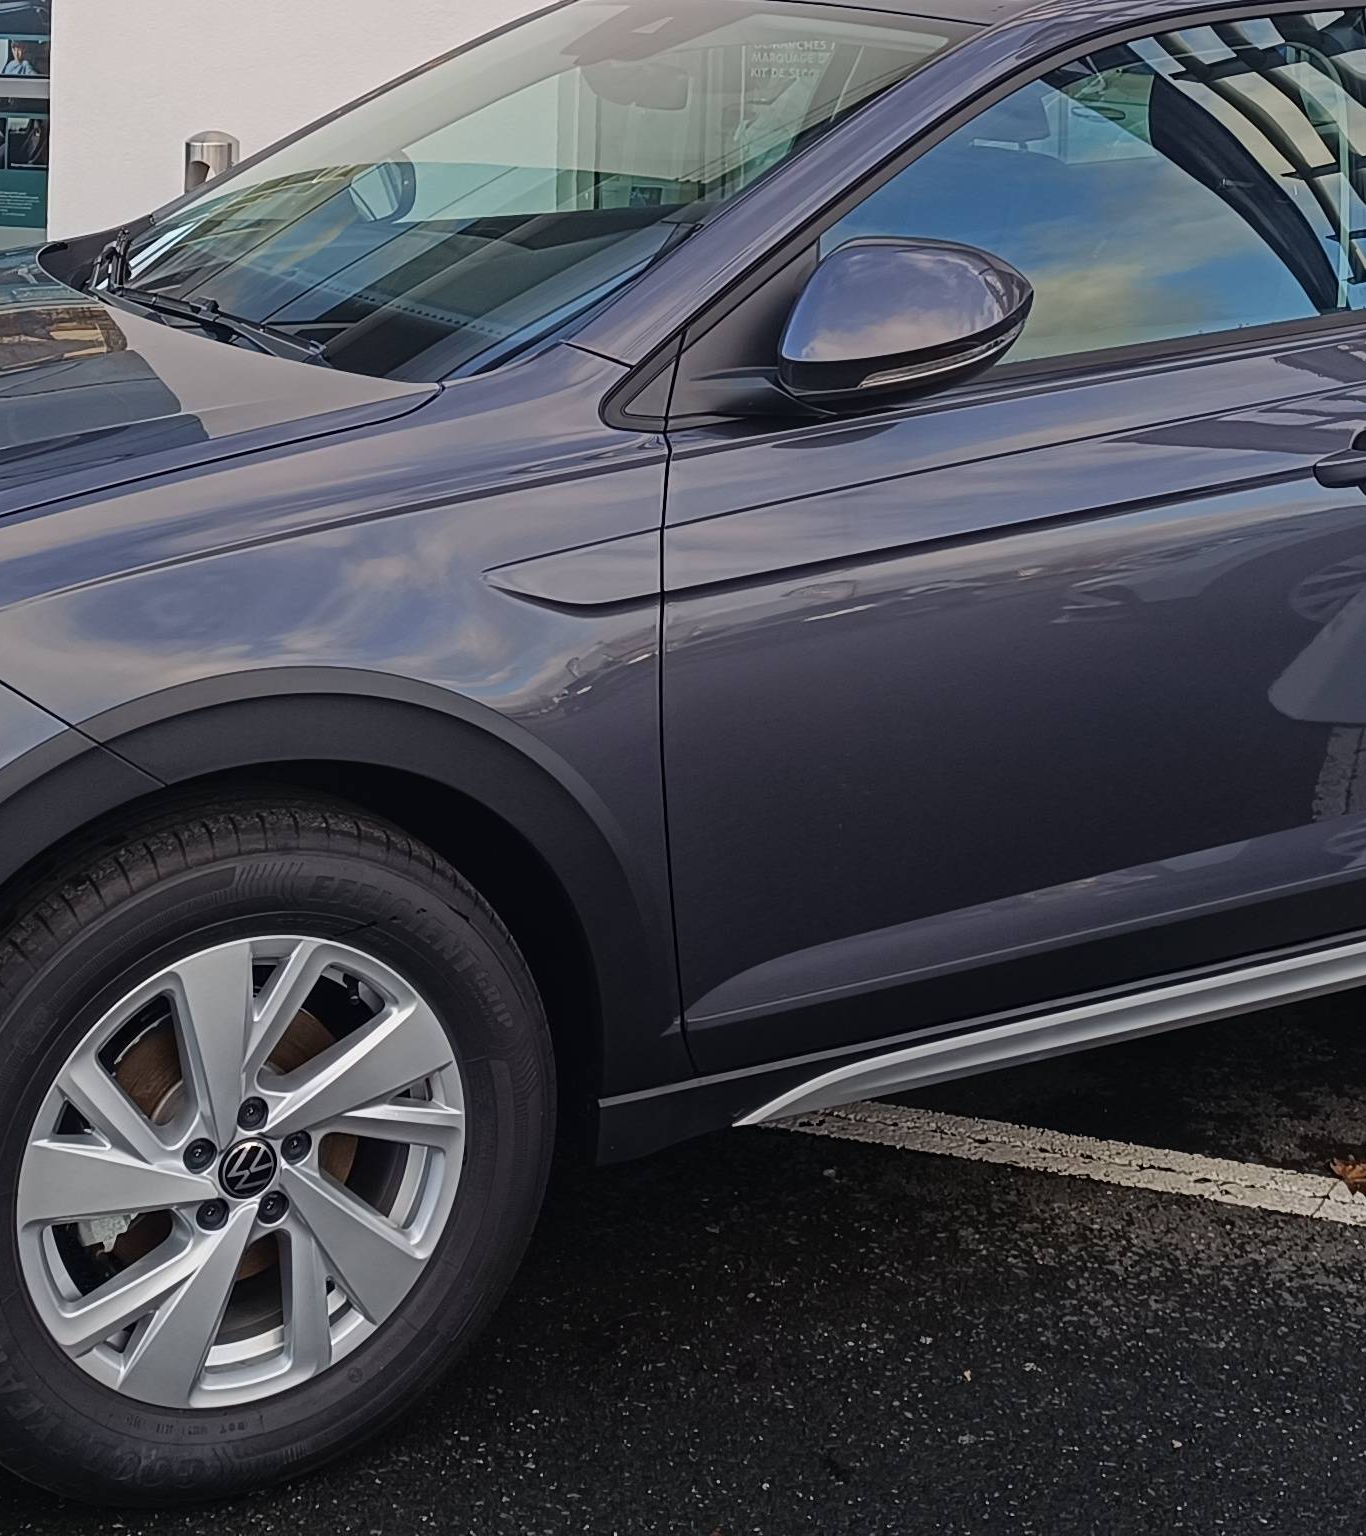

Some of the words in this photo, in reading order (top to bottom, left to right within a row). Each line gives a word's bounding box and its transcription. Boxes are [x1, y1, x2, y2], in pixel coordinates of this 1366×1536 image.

[751, 52, 813, 64] MARQUAGE
[750, 68, 766, 78] KIT
[771, 68, 785, 78] DE
